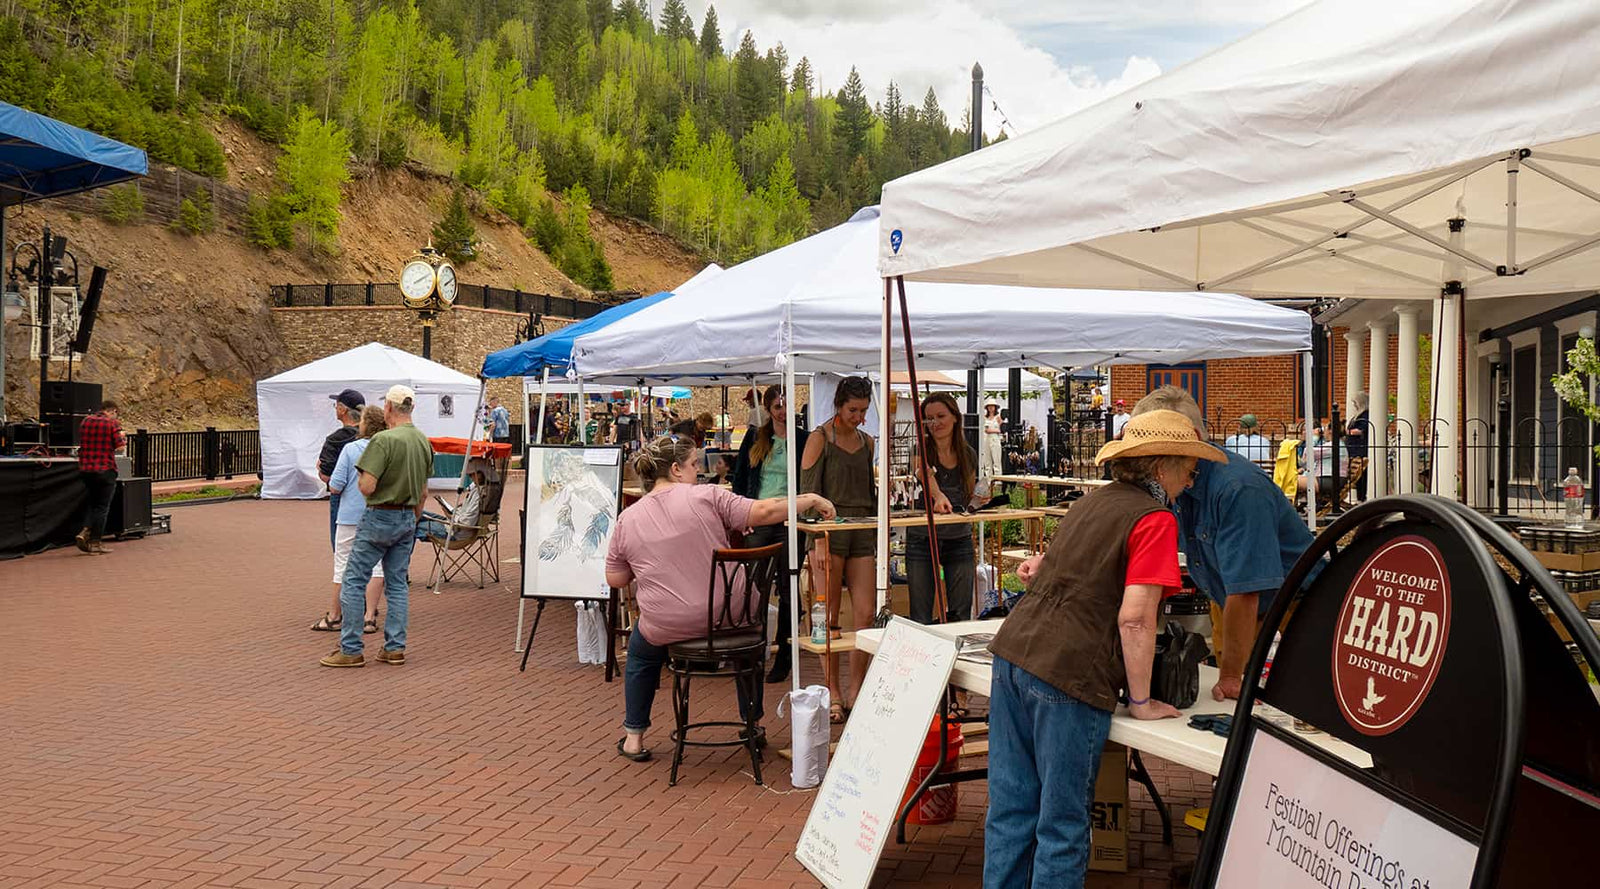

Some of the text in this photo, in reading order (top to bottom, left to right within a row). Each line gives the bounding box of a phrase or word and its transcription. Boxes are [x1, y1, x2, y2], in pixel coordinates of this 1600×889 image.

[1371, 568, 1439, 591] WELCOME
[1375, 584, 1426, 605] TO THE
[1343, 596, 1439, 668] HARD
[1348, 653, 1411, 683] DISTRICT
[1265, 782, 1406, 889] Festival Offerings
[1266, 818, 1343, 889] Mountain
